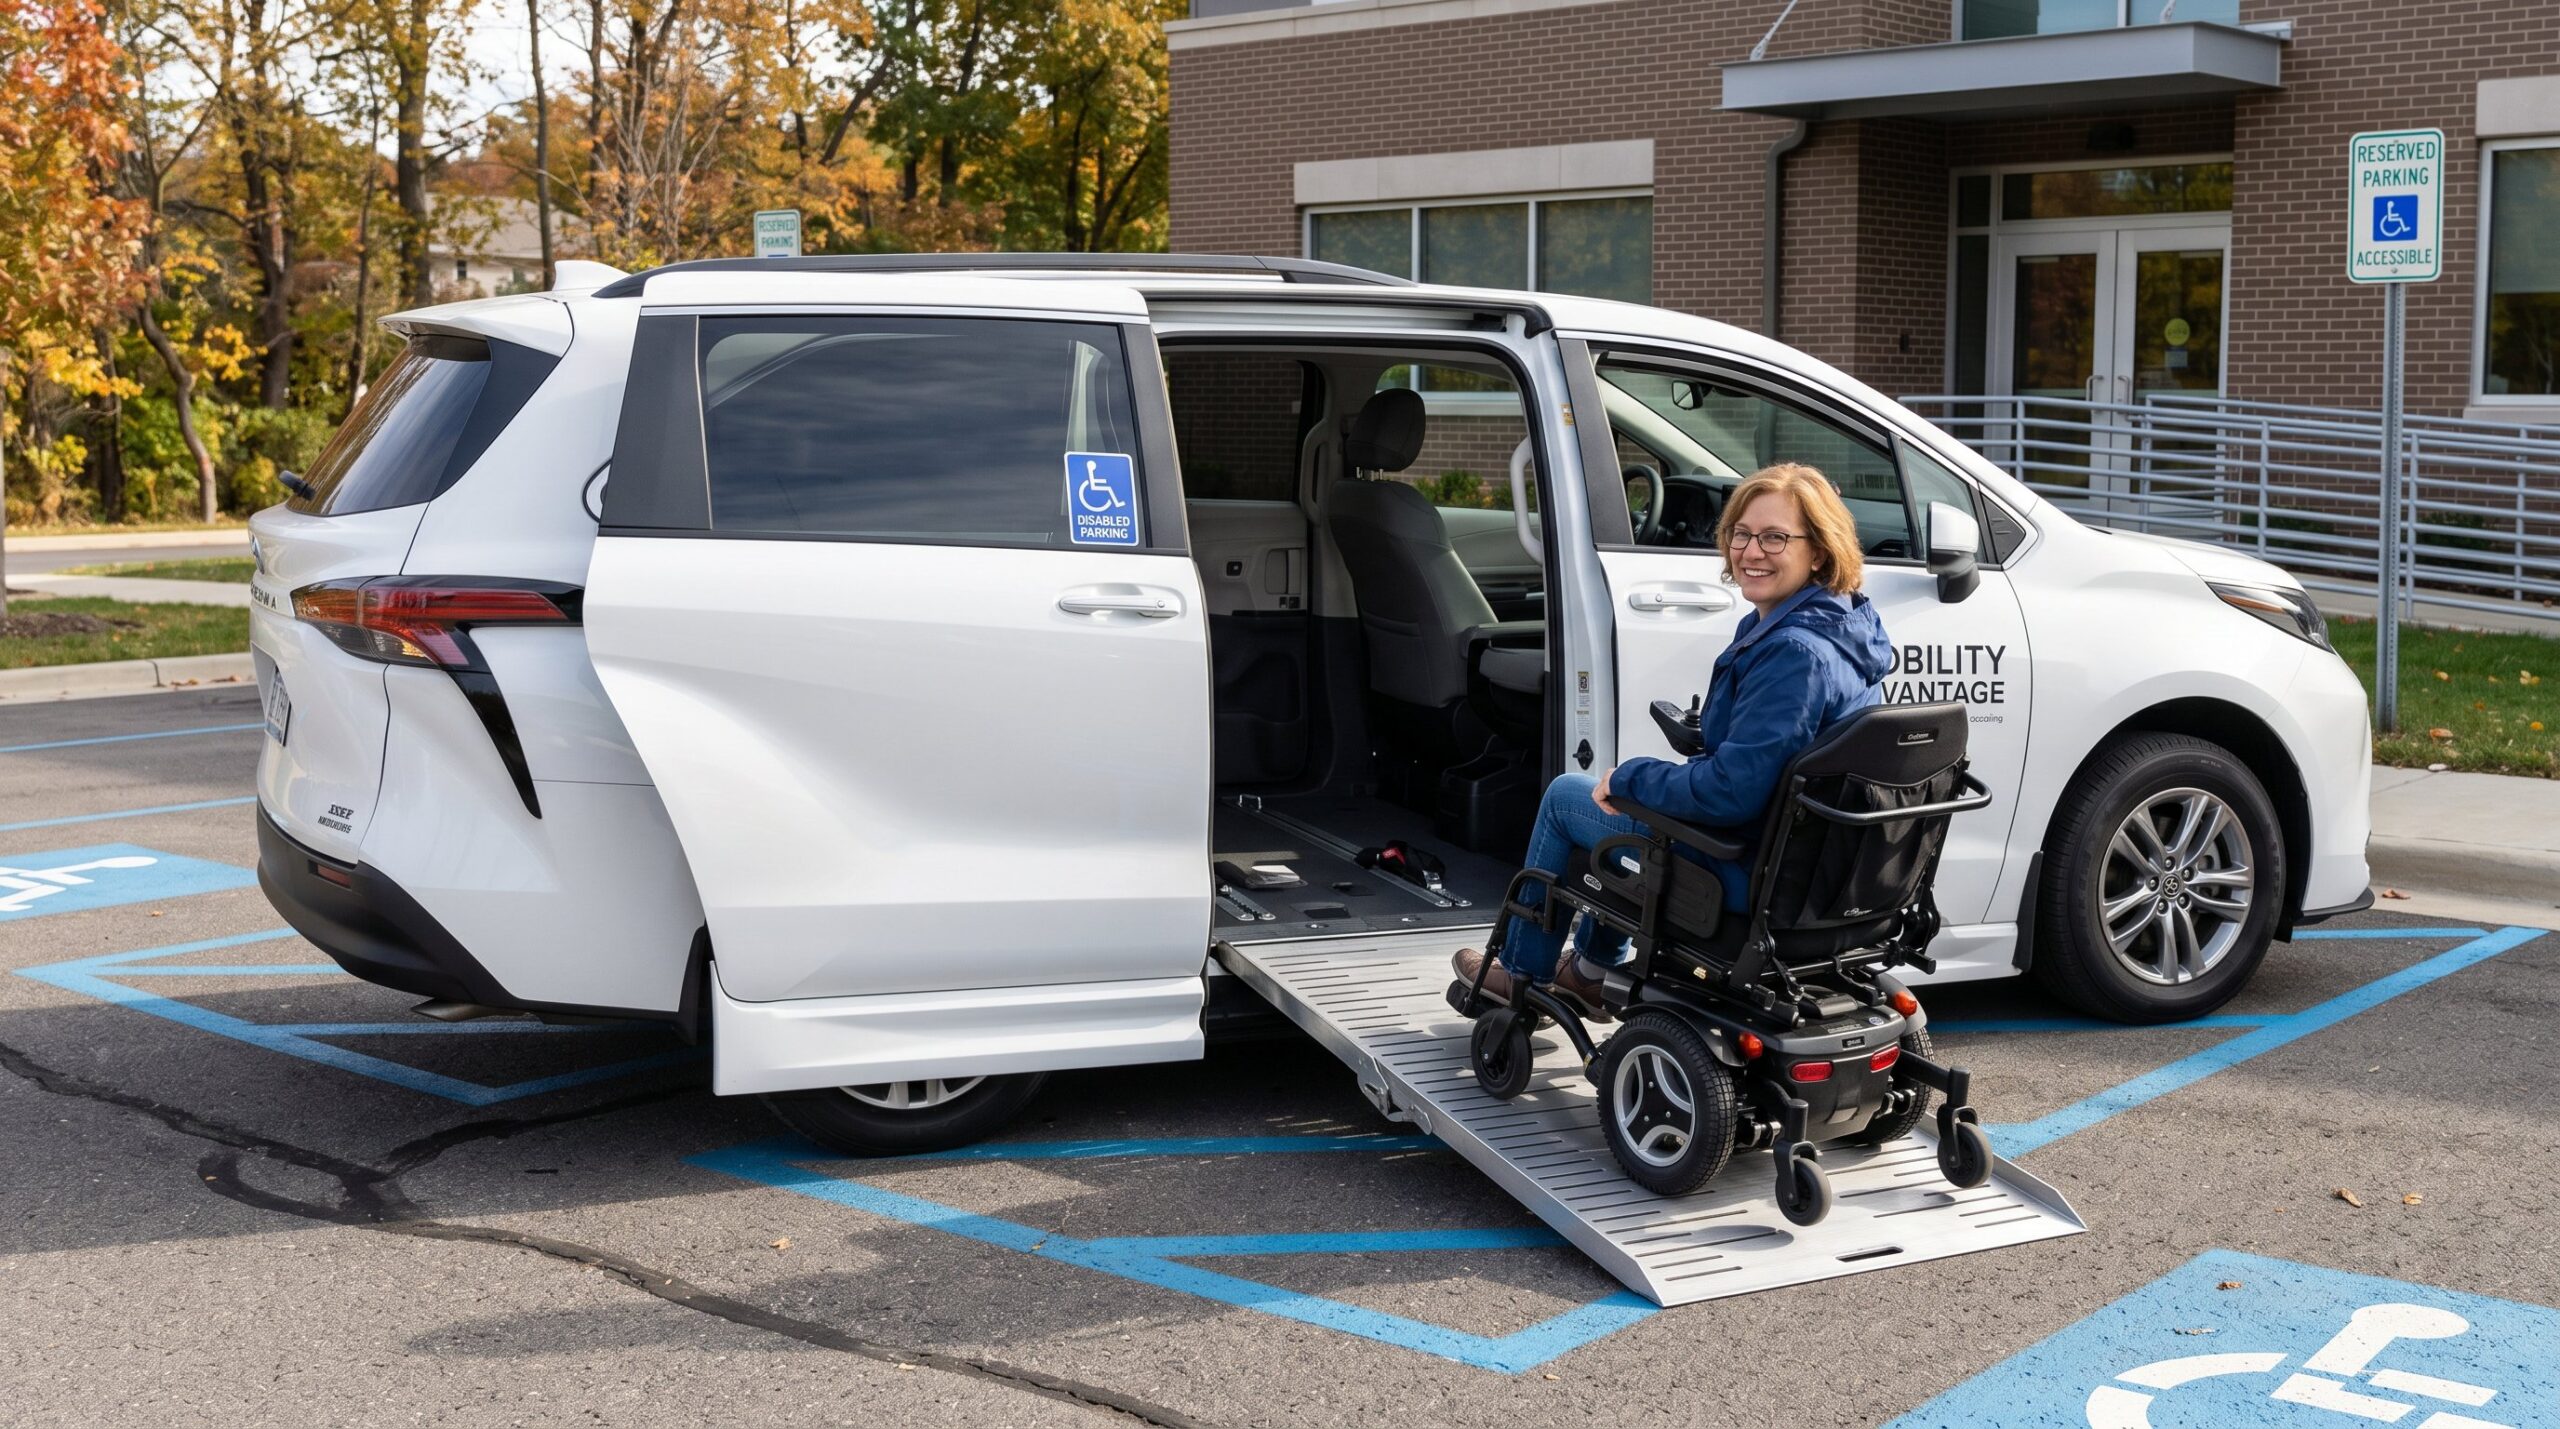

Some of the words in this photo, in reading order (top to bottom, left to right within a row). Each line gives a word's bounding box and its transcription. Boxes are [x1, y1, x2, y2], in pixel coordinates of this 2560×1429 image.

[2357, 141, 2436, 163] RESERVED
[2363, 167, 2429, 188] PARKING
[2356, 248, 2432, 266] ACCESSIBLE
[1077, 515, 1130, 527] DISABLED
[1080, 527, 1128, 539] PARKING
[1886, 645, 2006, 675] OBILITY
[1881, 681, 2005, 704] VANTAGE
